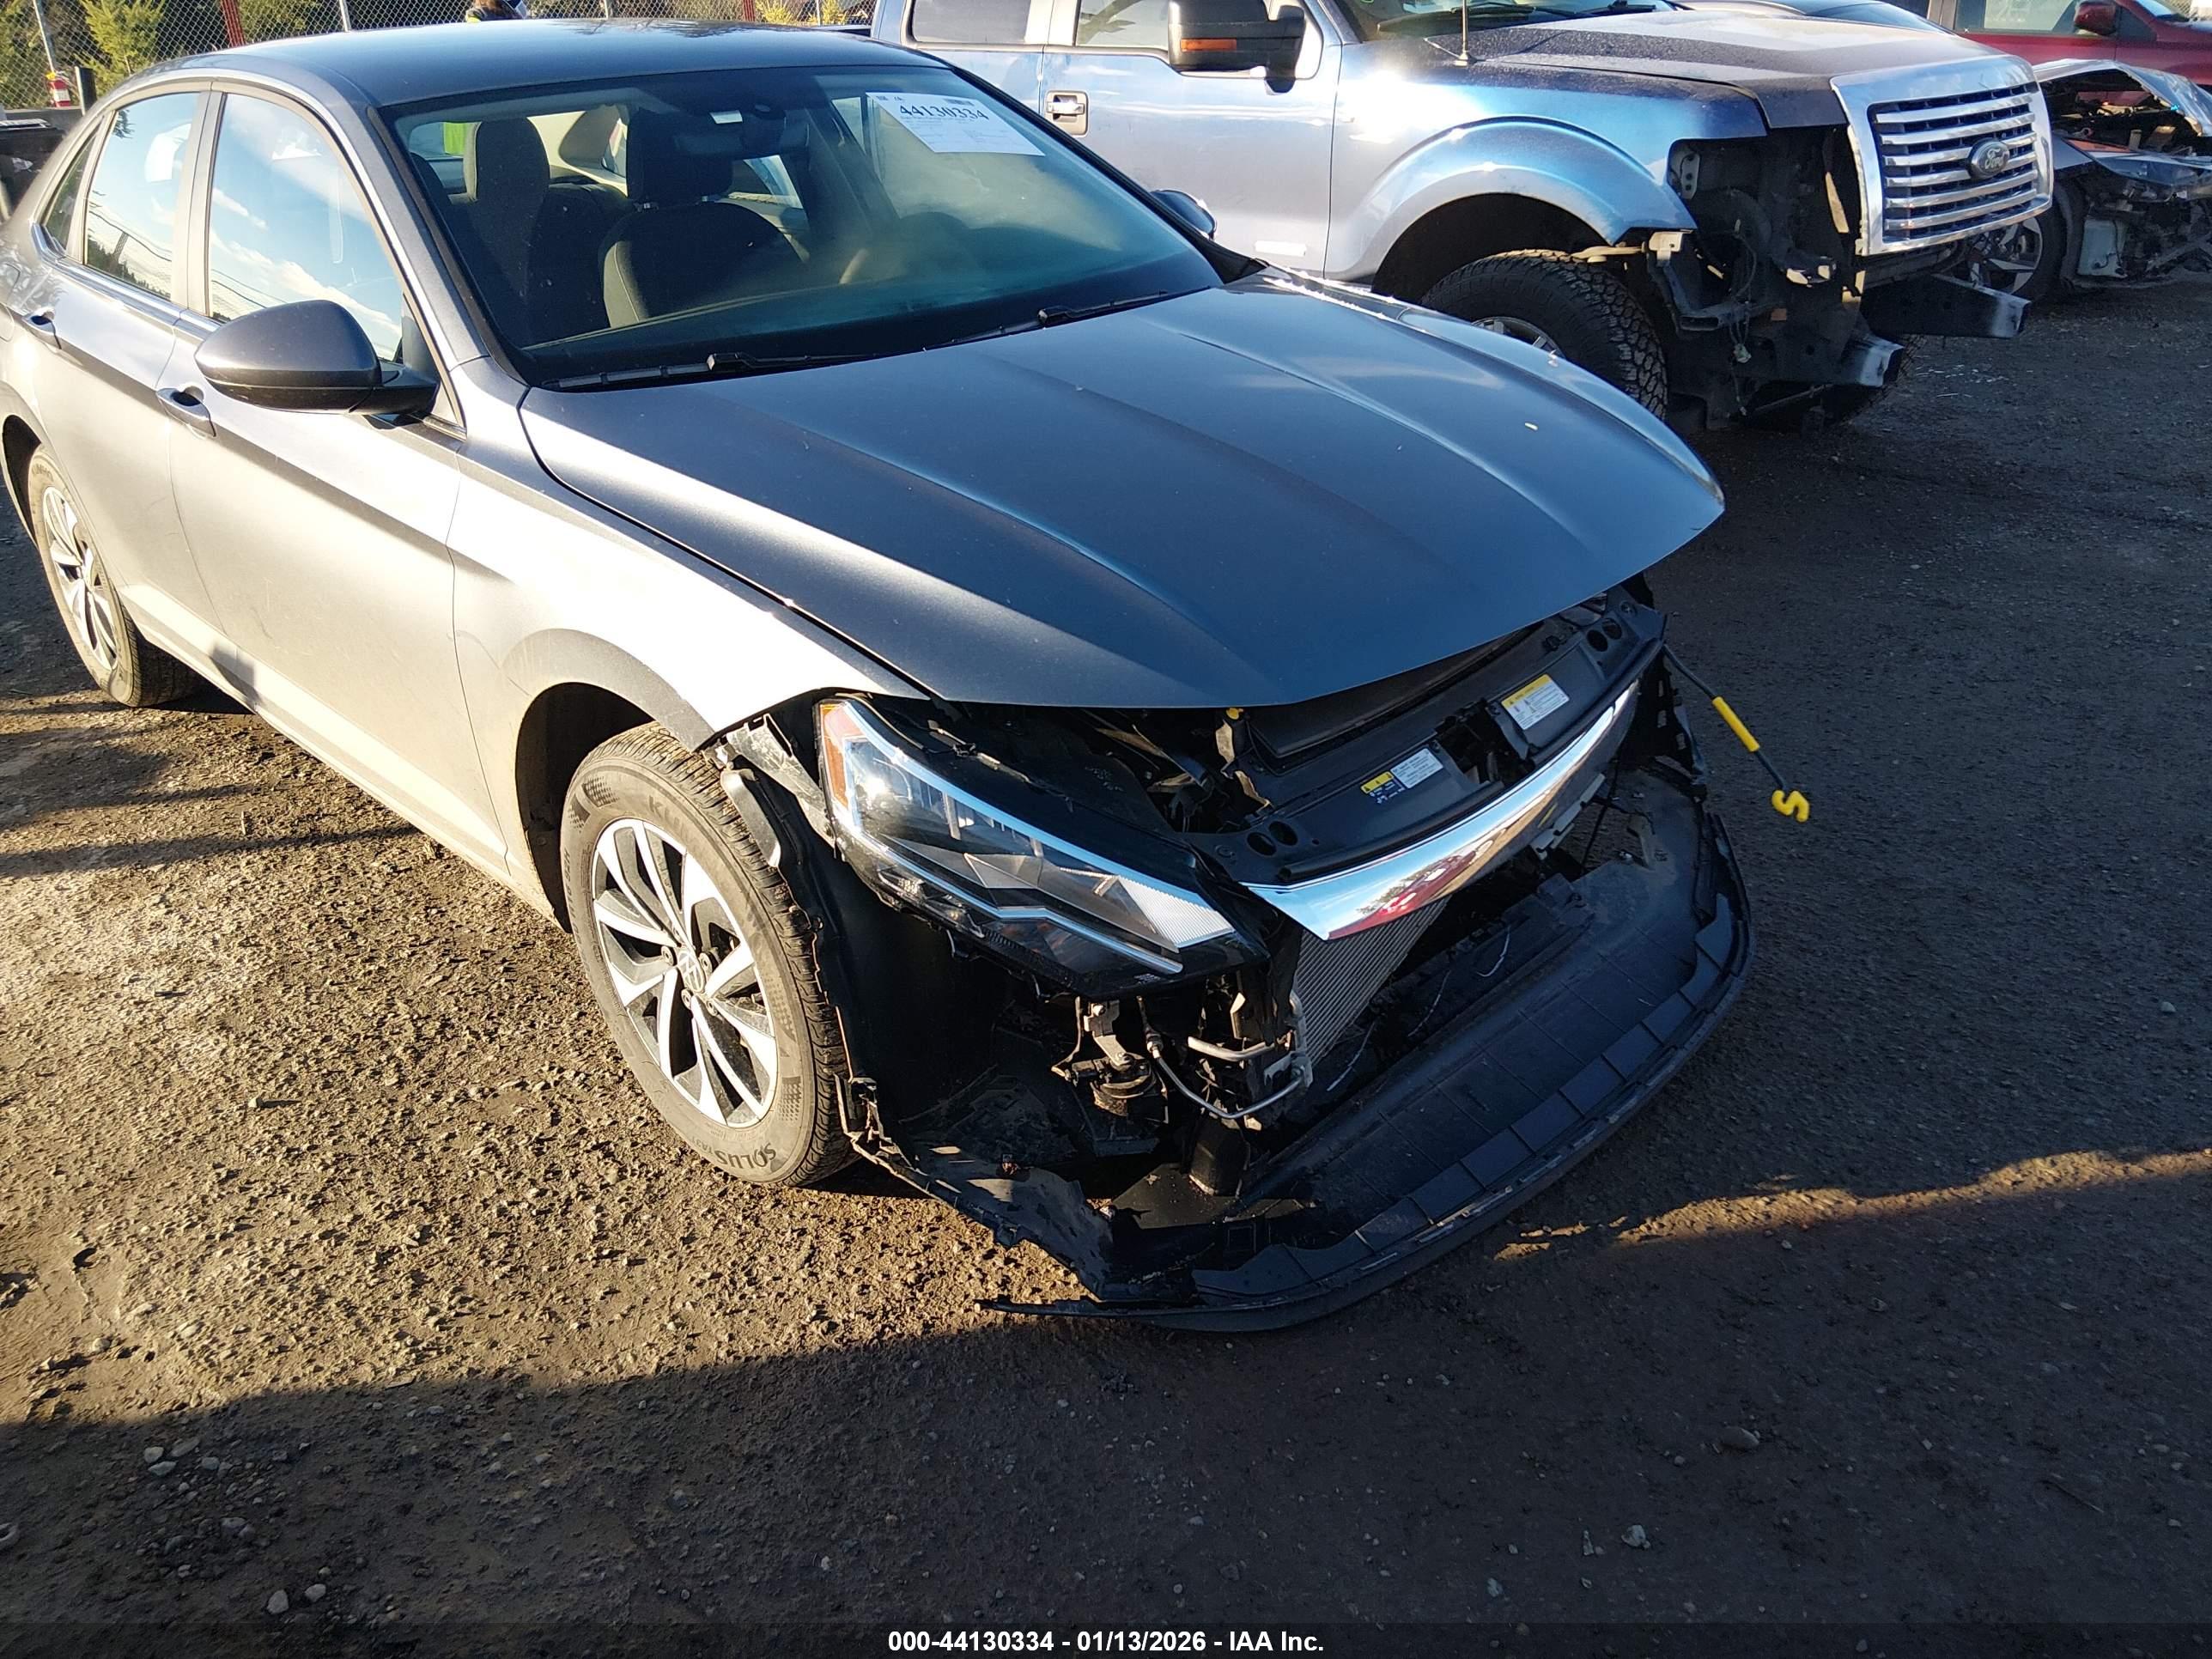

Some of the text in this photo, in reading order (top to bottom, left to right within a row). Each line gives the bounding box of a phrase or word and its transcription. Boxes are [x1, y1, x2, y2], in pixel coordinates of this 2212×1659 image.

[899, 105, 990, 121] 44130334
[1984, 148, 2010, 170] Ford
[714, 1142, 776, 1169] SOLUS
